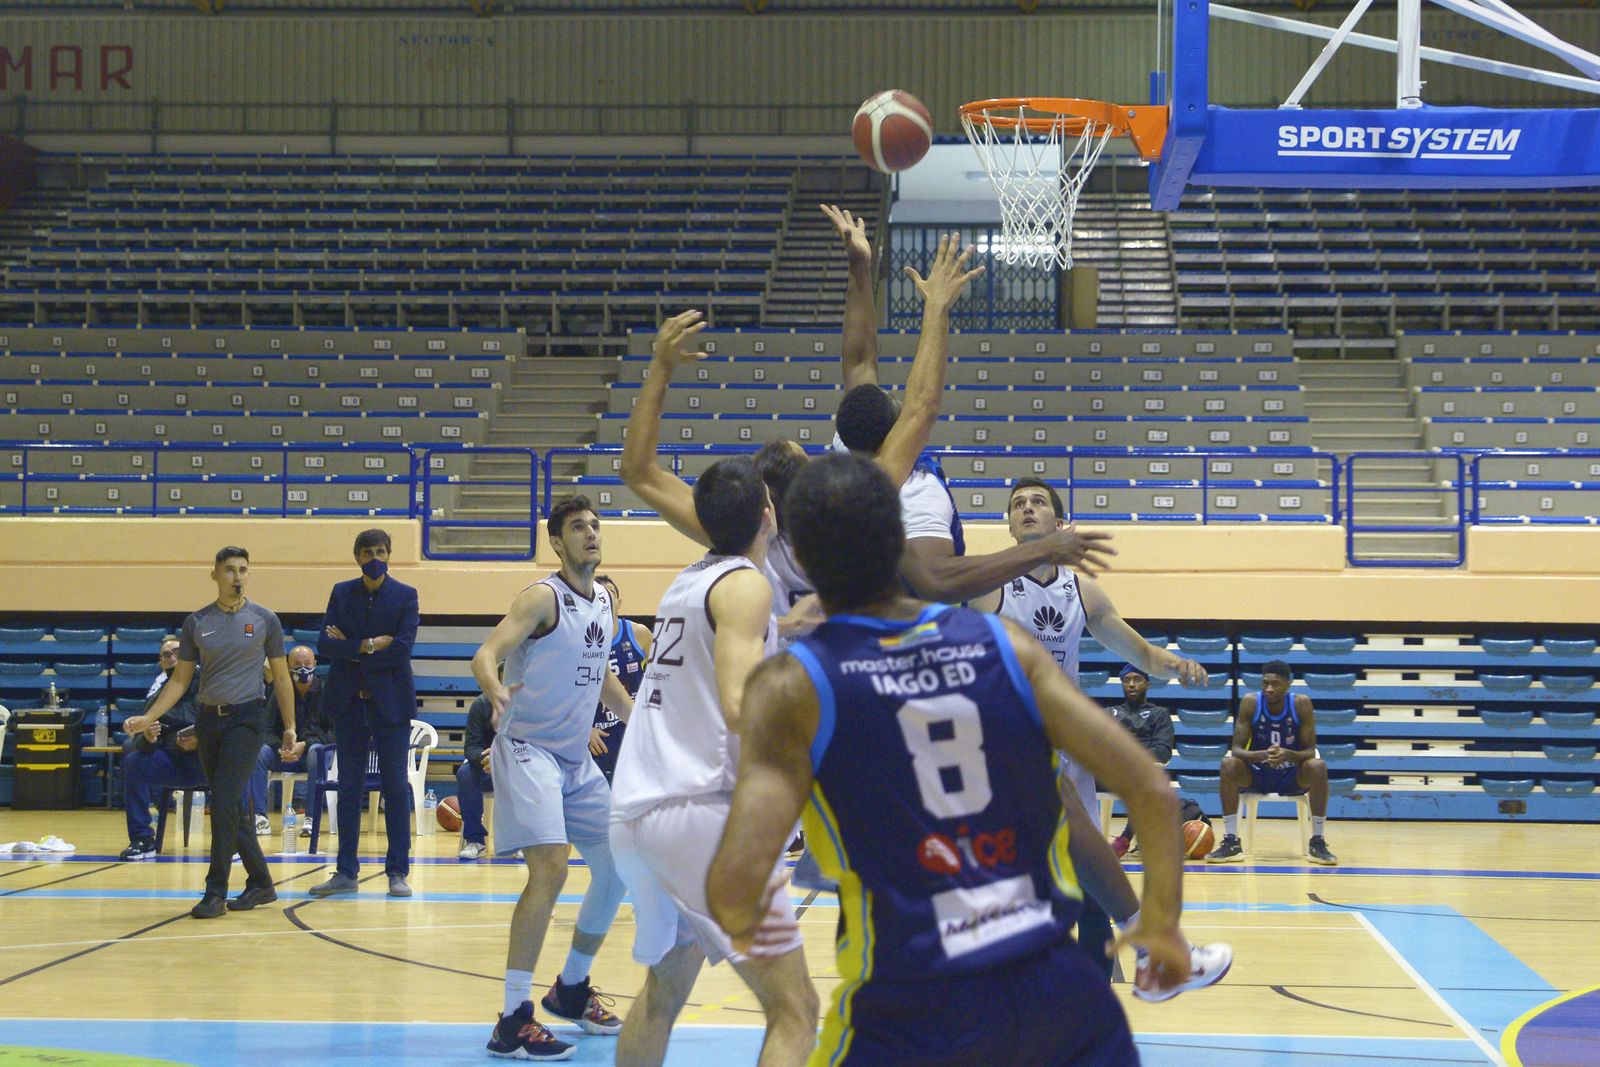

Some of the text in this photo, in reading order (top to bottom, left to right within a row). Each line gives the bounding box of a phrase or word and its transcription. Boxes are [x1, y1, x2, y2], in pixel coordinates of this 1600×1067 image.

[0, 45, 134, 91] MAR
[1277, 125, 1522, 155] SPORT SYSTEM
[648, 617, 685, 667] 32
[1034, 634, 1065, 643] HUAWEI
[582, 651, 605, 660] HUAWEI
[840, 643, 986, 675] master.house
[575, 666, 602, 686] 34
[871, 661, 977, 696] IAGO ED
[1271, 731, 1281, 745] 0
[897, 693, 993, 819] 8
